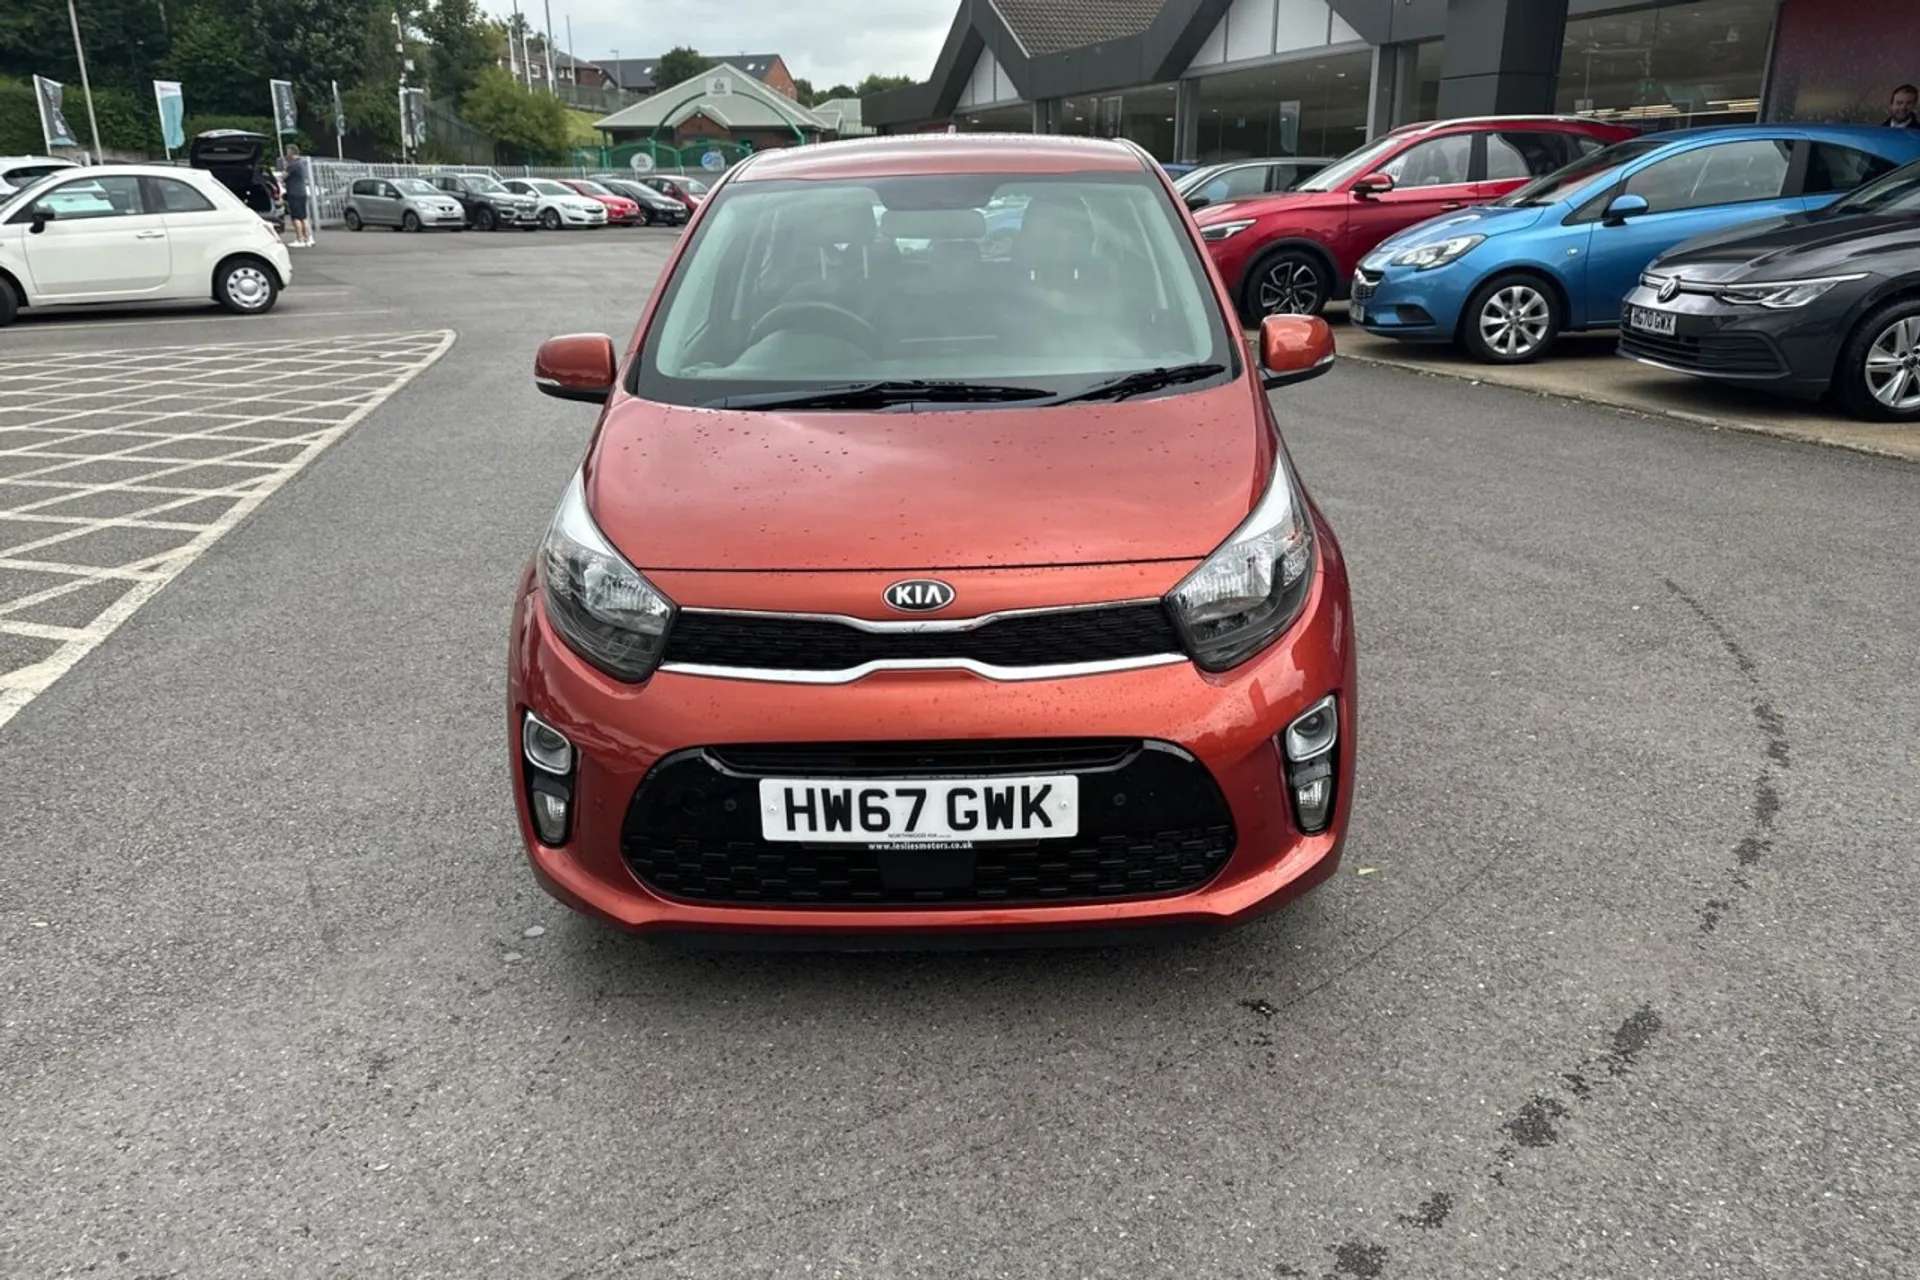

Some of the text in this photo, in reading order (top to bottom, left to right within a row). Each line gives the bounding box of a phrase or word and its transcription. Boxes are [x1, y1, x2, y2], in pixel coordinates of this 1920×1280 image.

[895, 584, 943, 605] KIA
[783, 784, 1053, 832] HW67 GWK
[868, 840, 973, 850] www.lesliesmotors.co.uk
